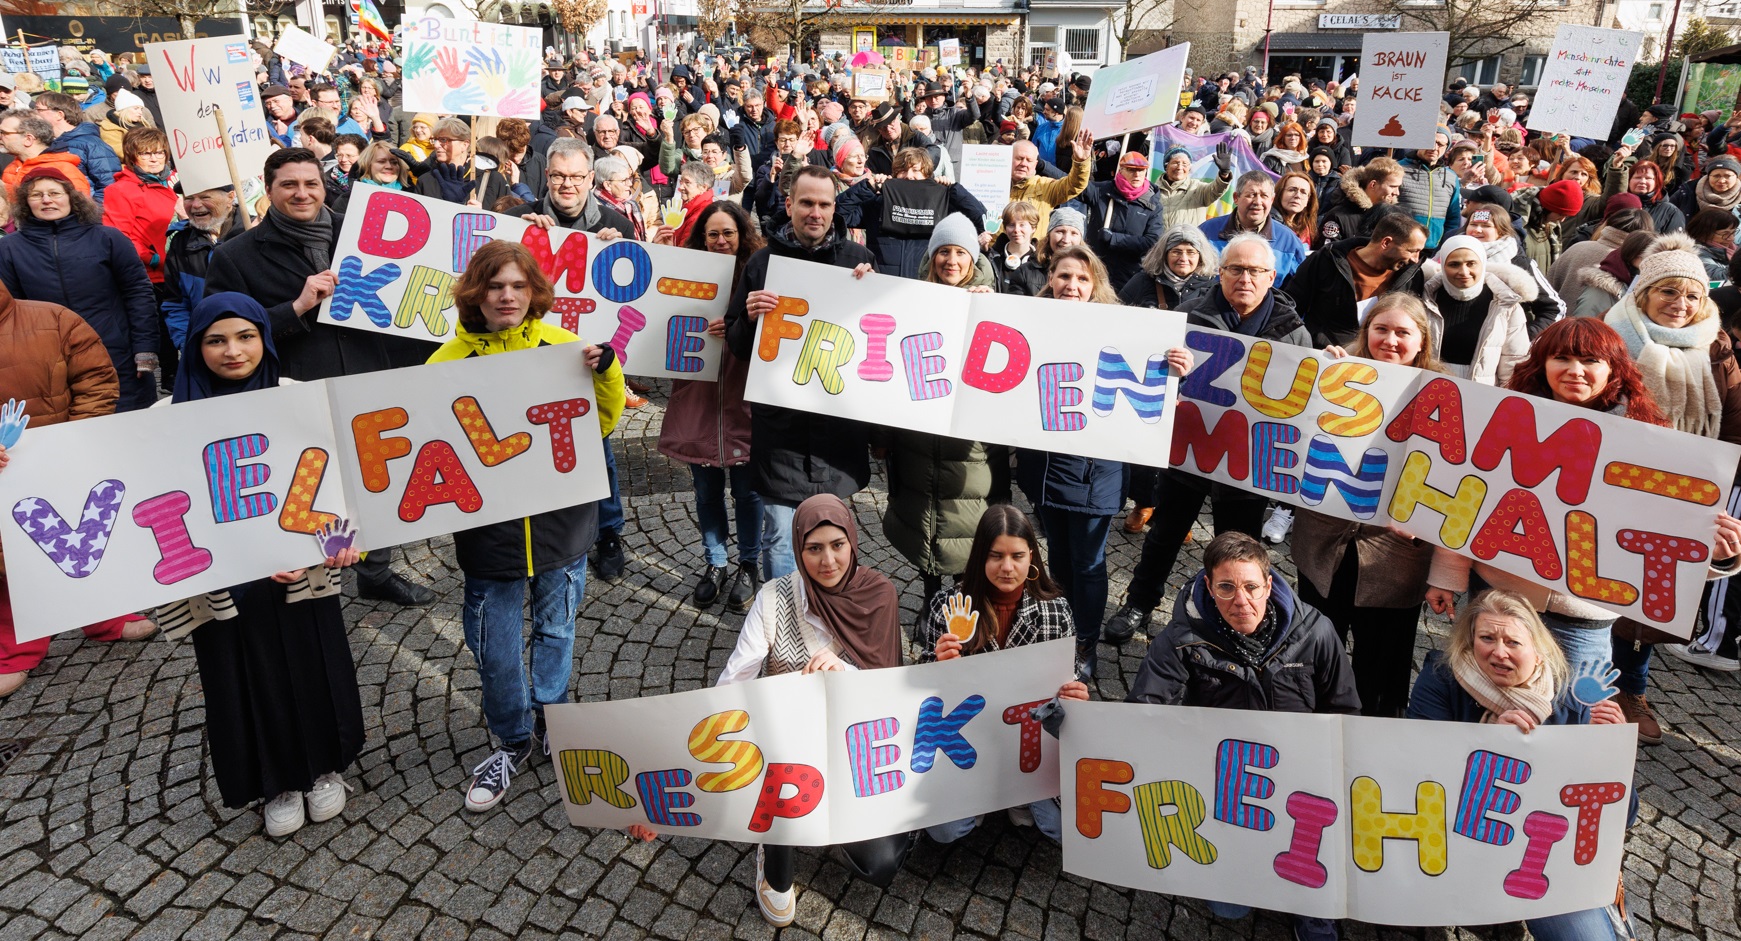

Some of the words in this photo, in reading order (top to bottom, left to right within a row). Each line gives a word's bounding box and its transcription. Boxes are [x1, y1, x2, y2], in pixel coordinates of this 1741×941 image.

[419, 17, 482, 44] Bunt
[1371, 50, 1427, 69] BRAUN
[1557, 50, 1626, 68] Menschenrechte
[1575, 81, 1611, 95] Menschen
[1371, 85, 1424, 103] KACKE
[357, 190, 719, 304] DEMO-
[329, 255, 709, 373] KRTIE
[758, 296, 1169, 432] FRIEDEN
[1185, 329, 1721, 506] ZUSAM-
[12, 396, 591, 585] VIELFALT
[1169, 400, 1709, 623] MENHALT
[559, 694, 1057, 832] RESPEKT
[1075, 738, 1627, 900] FREIHEIT
